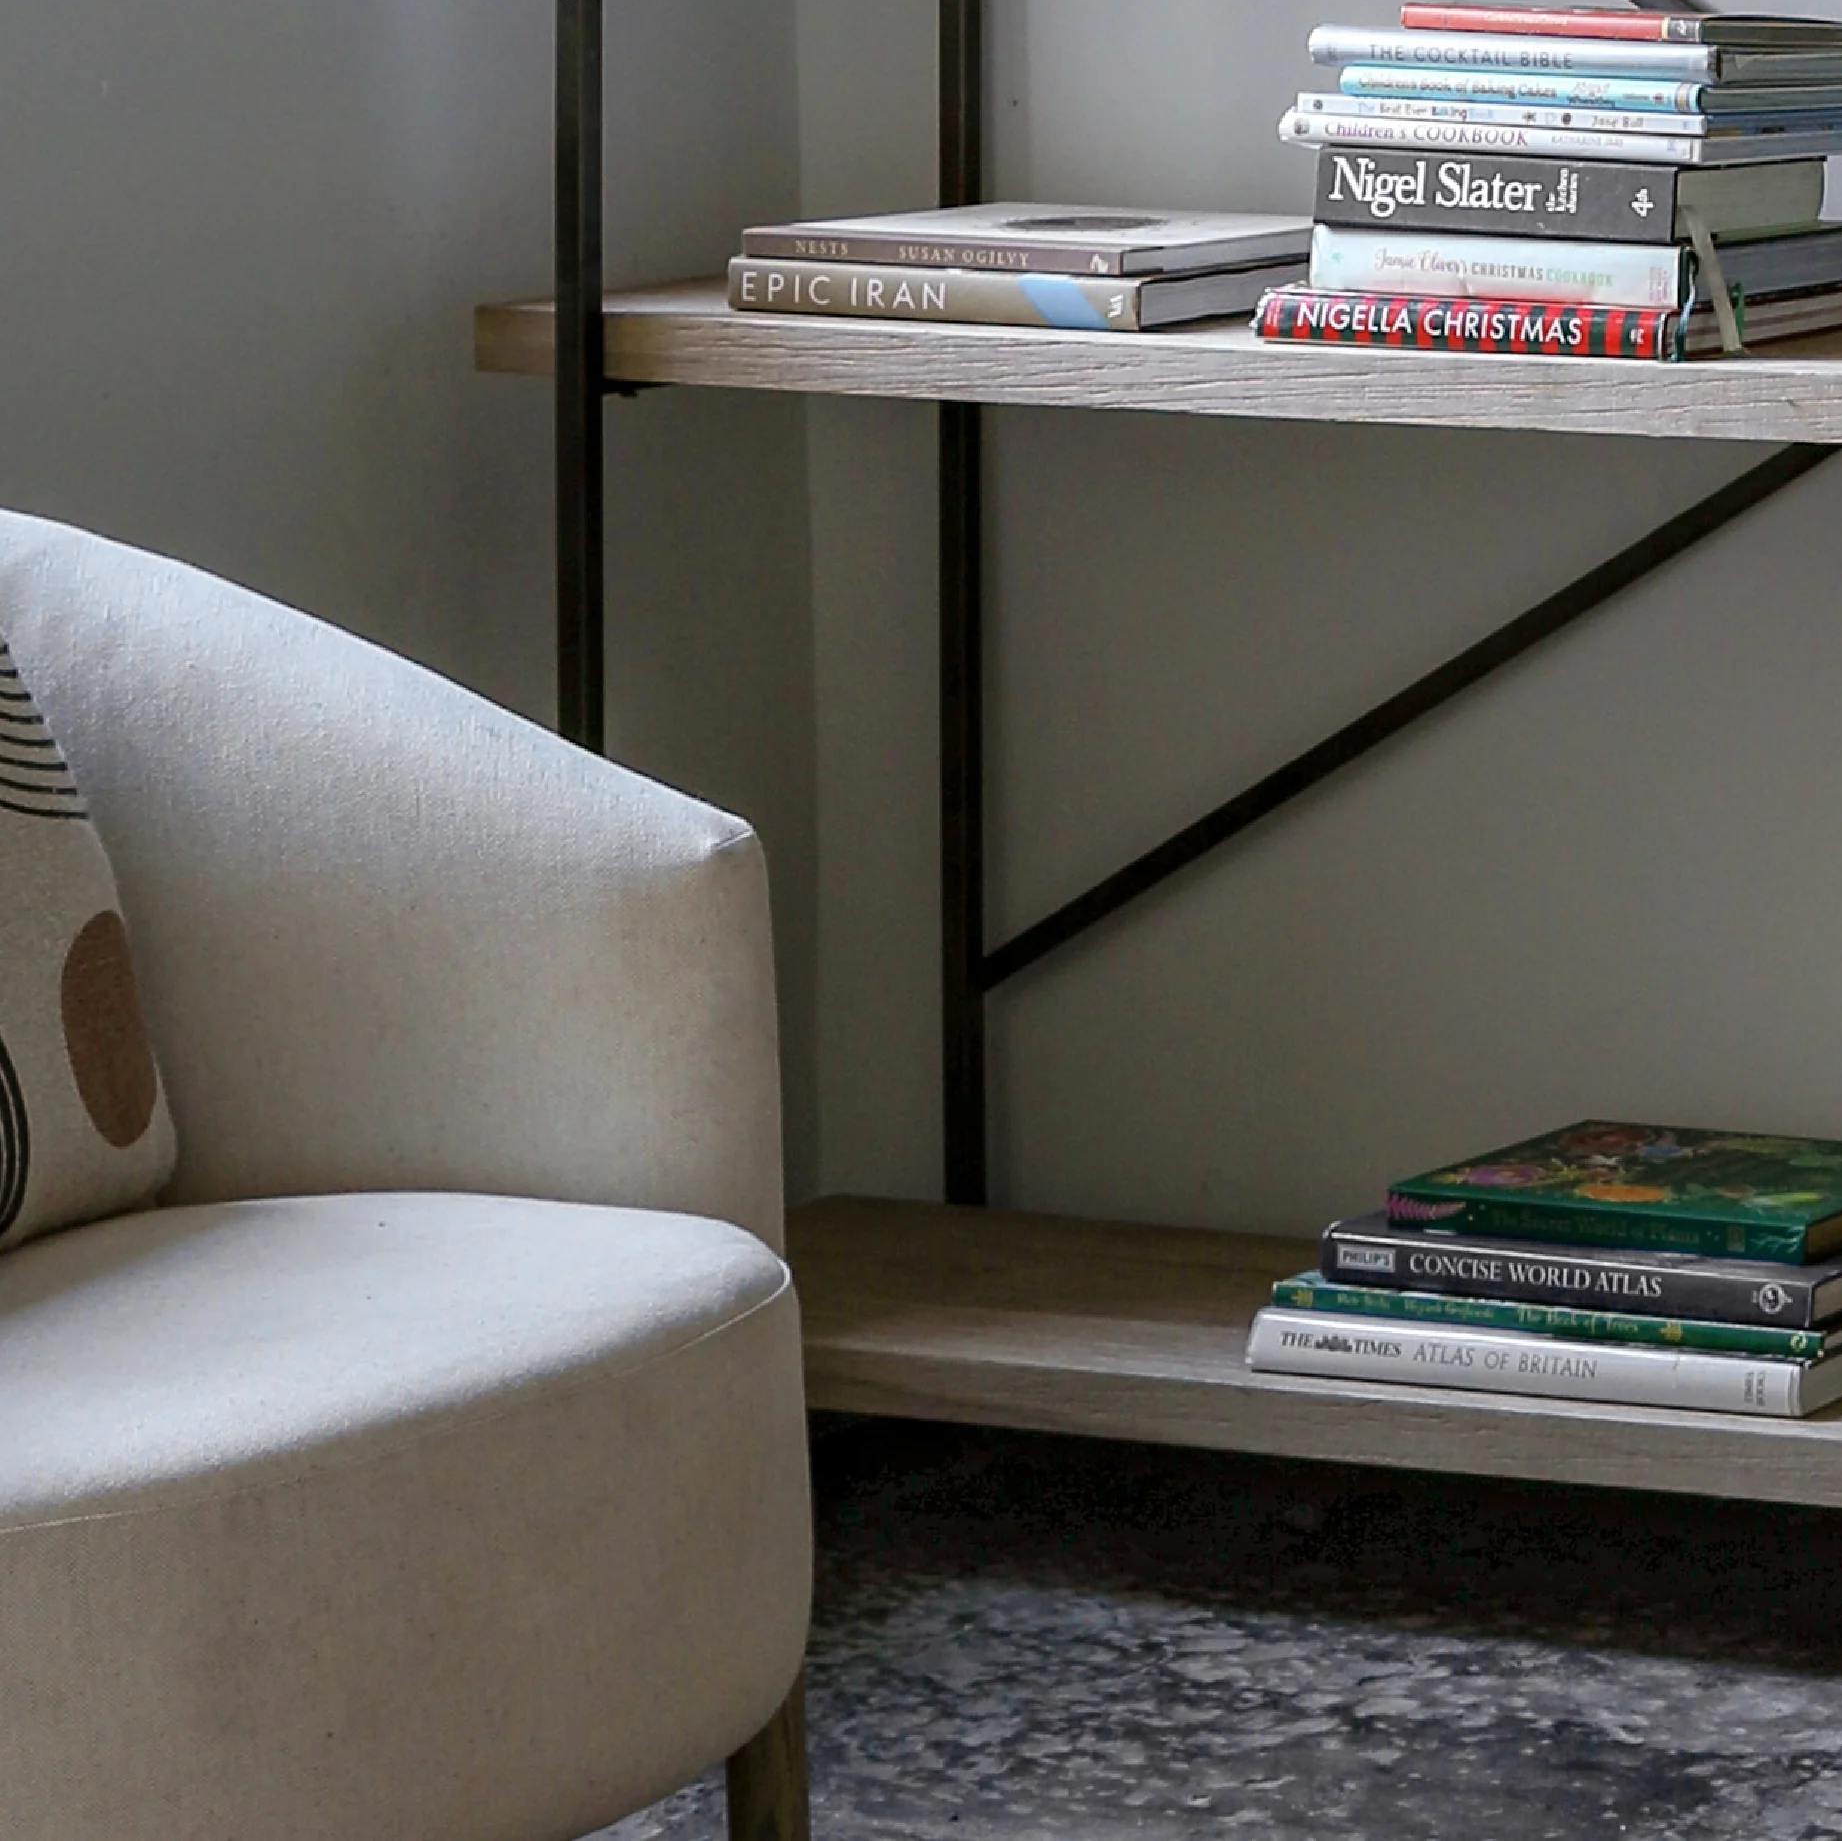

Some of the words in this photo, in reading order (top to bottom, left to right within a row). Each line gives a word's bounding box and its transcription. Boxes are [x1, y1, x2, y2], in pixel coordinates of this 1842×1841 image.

[1369, 43, 1404, 62] THE
[1413, 46, 1512, 68] COCKTAIL
[1521, 51, 1574, 70] BIBLE
[1419, 76, 1451, 93] Book
[1455, 77, 1469, 94] of
[1472, 79, 1516, 99] Baking
[1412, 124, 1529, 147] COOKBOOK
[1327, 156, 1427, 217] Nigel
[1434, 161, 1543, 212] Slater
[794, 240, 849, 257] NESTS
[899, 245, 956, 263] SUSAN
[961, 249, 1030, 268] OGILVY
[741, 271, 832, 307] EPIC
[850, 276, 946, 310] IRAN
[1471, 262, 1544, 280] CHRISTMAS
[1545, 267, 1613, 287] COOKBOOK
[1296, 303, 1412, 334] NIGELLA
[1423, 308, 1583, 345] CHRISTMAS
[1409, 1253, 1503, 1282] CONCISE
[1508, 1261, 1590, 1290] WORLD
[1594, 1272, 1662, 1298] ATLAS
[1280, 1331, 1314, 1348] THE
[1352, 1338, 1402, 1358] TIMES
[1413, 1342, 1475, 1368] ATLAS
[1484, 1351, 1511, 1371] OF
[1517, 1353, 1598, 1378] BRITAIN
